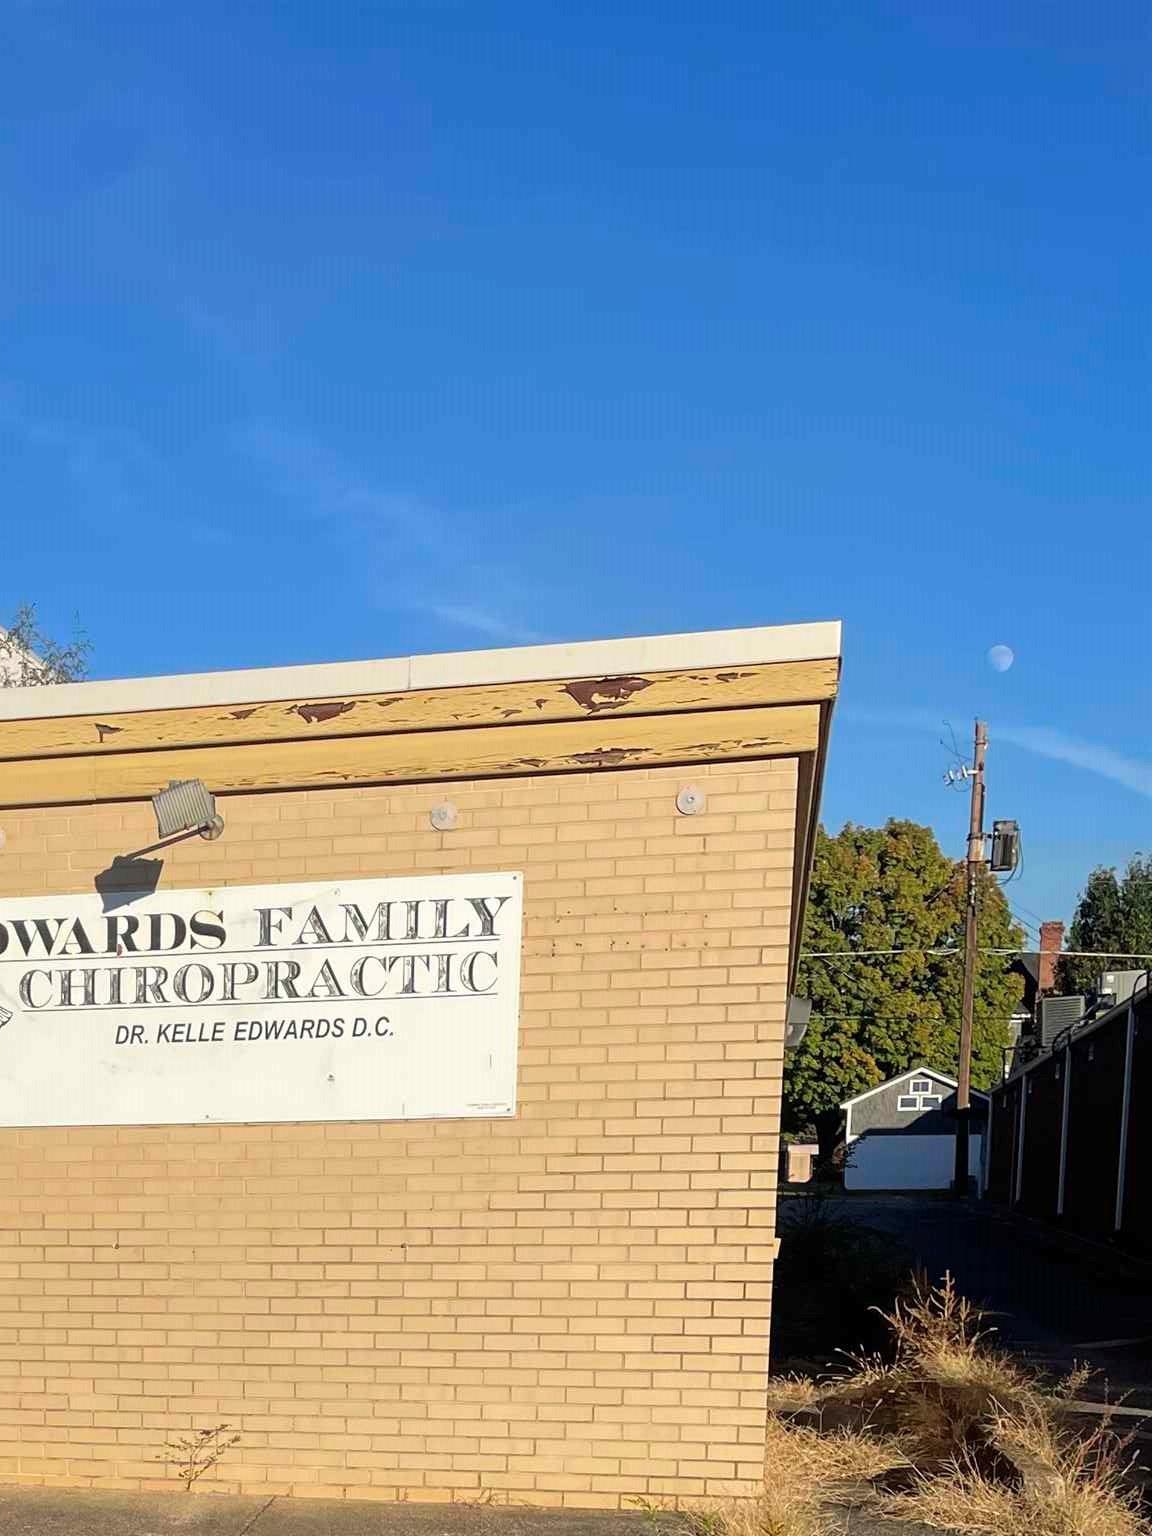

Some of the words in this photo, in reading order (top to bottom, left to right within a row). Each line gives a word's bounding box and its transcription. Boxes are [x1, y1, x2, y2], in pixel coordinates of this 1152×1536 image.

[254, 896, 512, 947] FAMILY
[18, 951, 498, 1009] CHIROPRACTIC
[114, 1024, 149, 1045] DR.
[156, 1022, 225, 1044] KELLE
[234, 1018, 345, 1041] EDWARDS
[352, 1016, 394, 1038] D.C.
